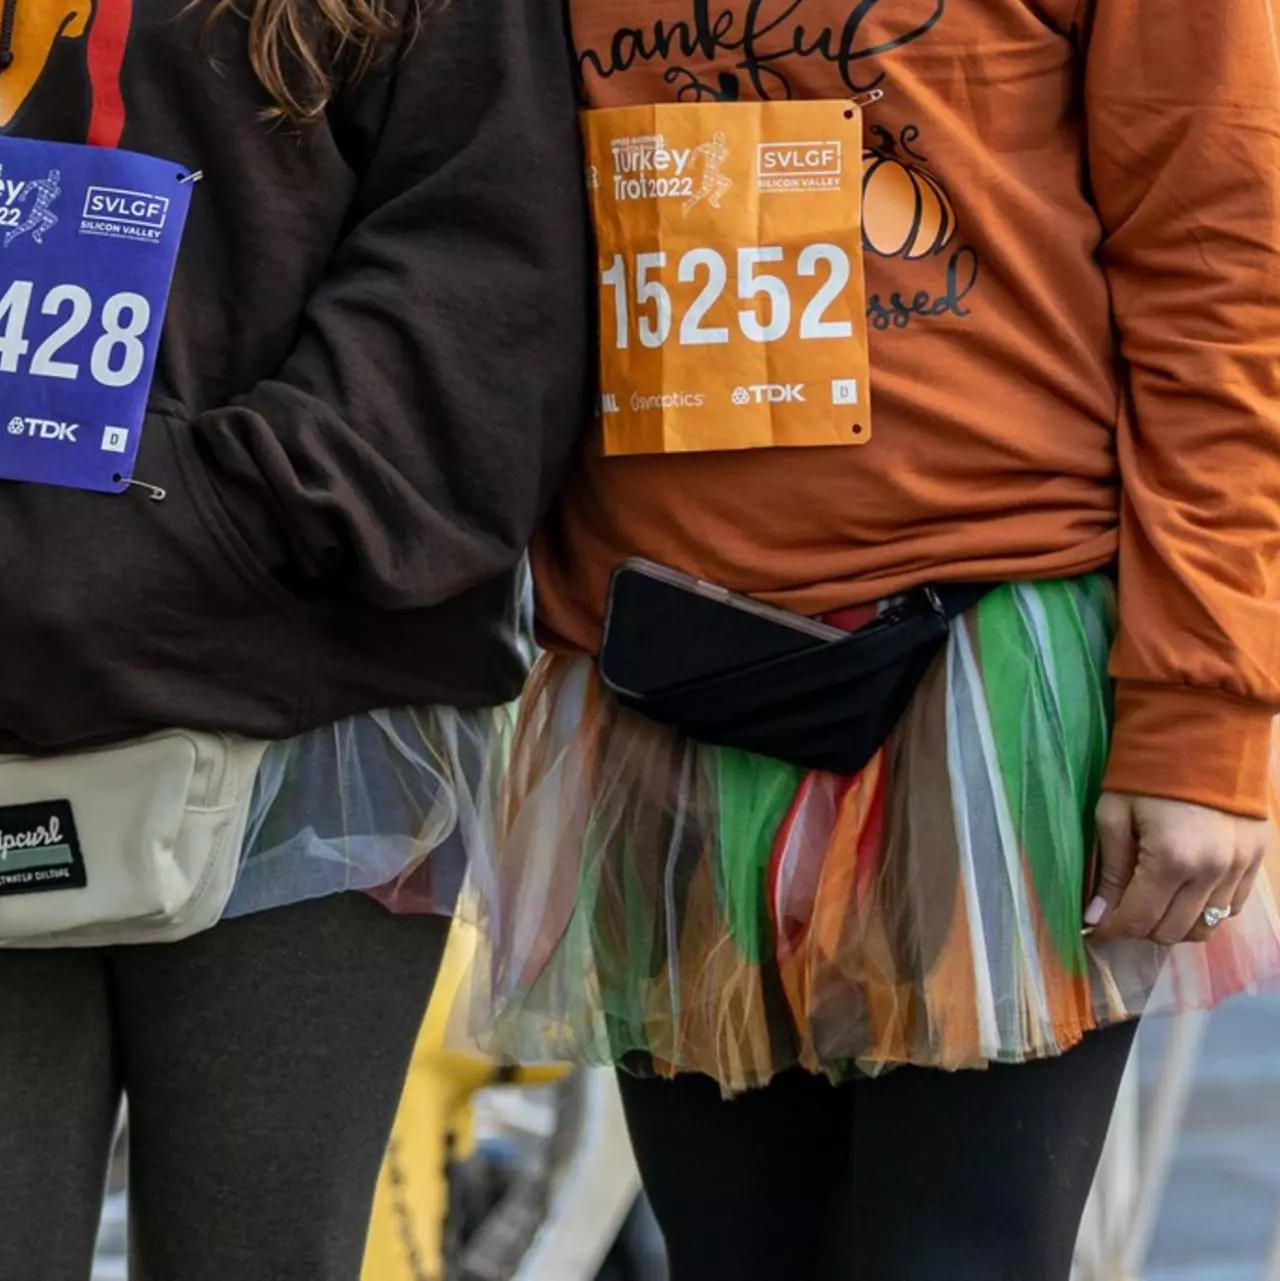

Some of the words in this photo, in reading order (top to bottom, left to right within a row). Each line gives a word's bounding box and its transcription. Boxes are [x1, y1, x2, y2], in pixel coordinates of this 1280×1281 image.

[611, 147, 691, 175] Turkey
[764, 150, 834, 168] SVLGF
[613, 174, 648, 200] Trot
[648, 176, 693, 197] 2022
[801, 177, 840, 187] VALLEY
[91, 195, 161, 218] SVLGF
[80, 220, 121, 232] SILICON
[122, 225, 161, 238] VALLEY
[601, 242, 853, 349] 15252
[866, 244, 979, 332] ssed
[749, 383, 807, 404] TDK
[24, 418, 80, 443] TDK
